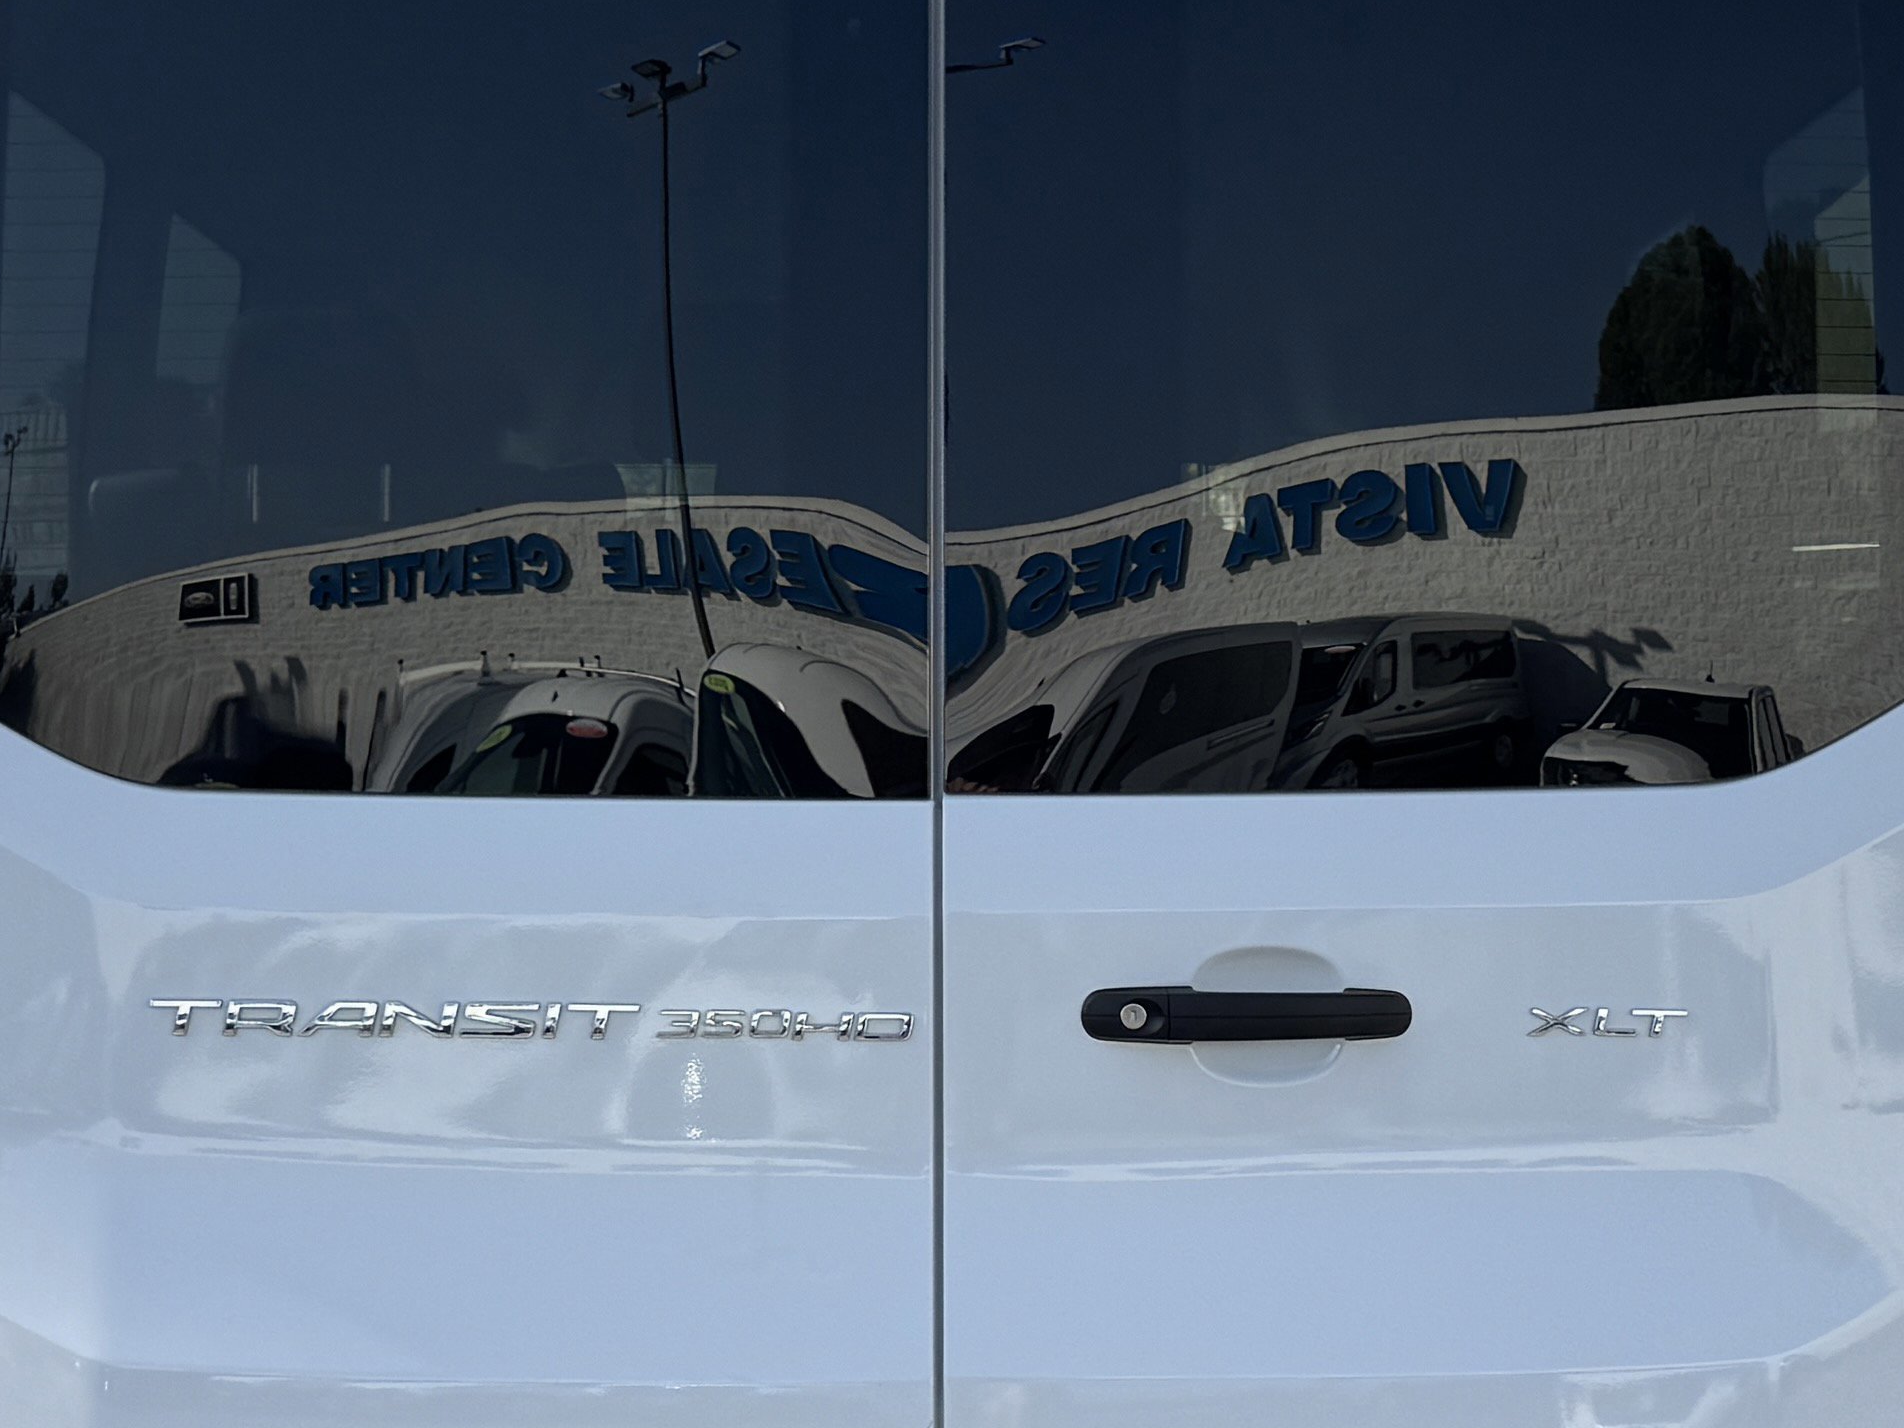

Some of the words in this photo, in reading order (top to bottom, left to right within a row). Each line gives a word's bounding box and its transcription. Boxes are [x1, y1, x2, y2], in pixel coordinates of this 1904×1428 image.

[150, 999, 640, 1040] TRANSIT
[656, 1009, 915, 1041] 350HD
[1527, 1007, 1688, 1037] XLT
